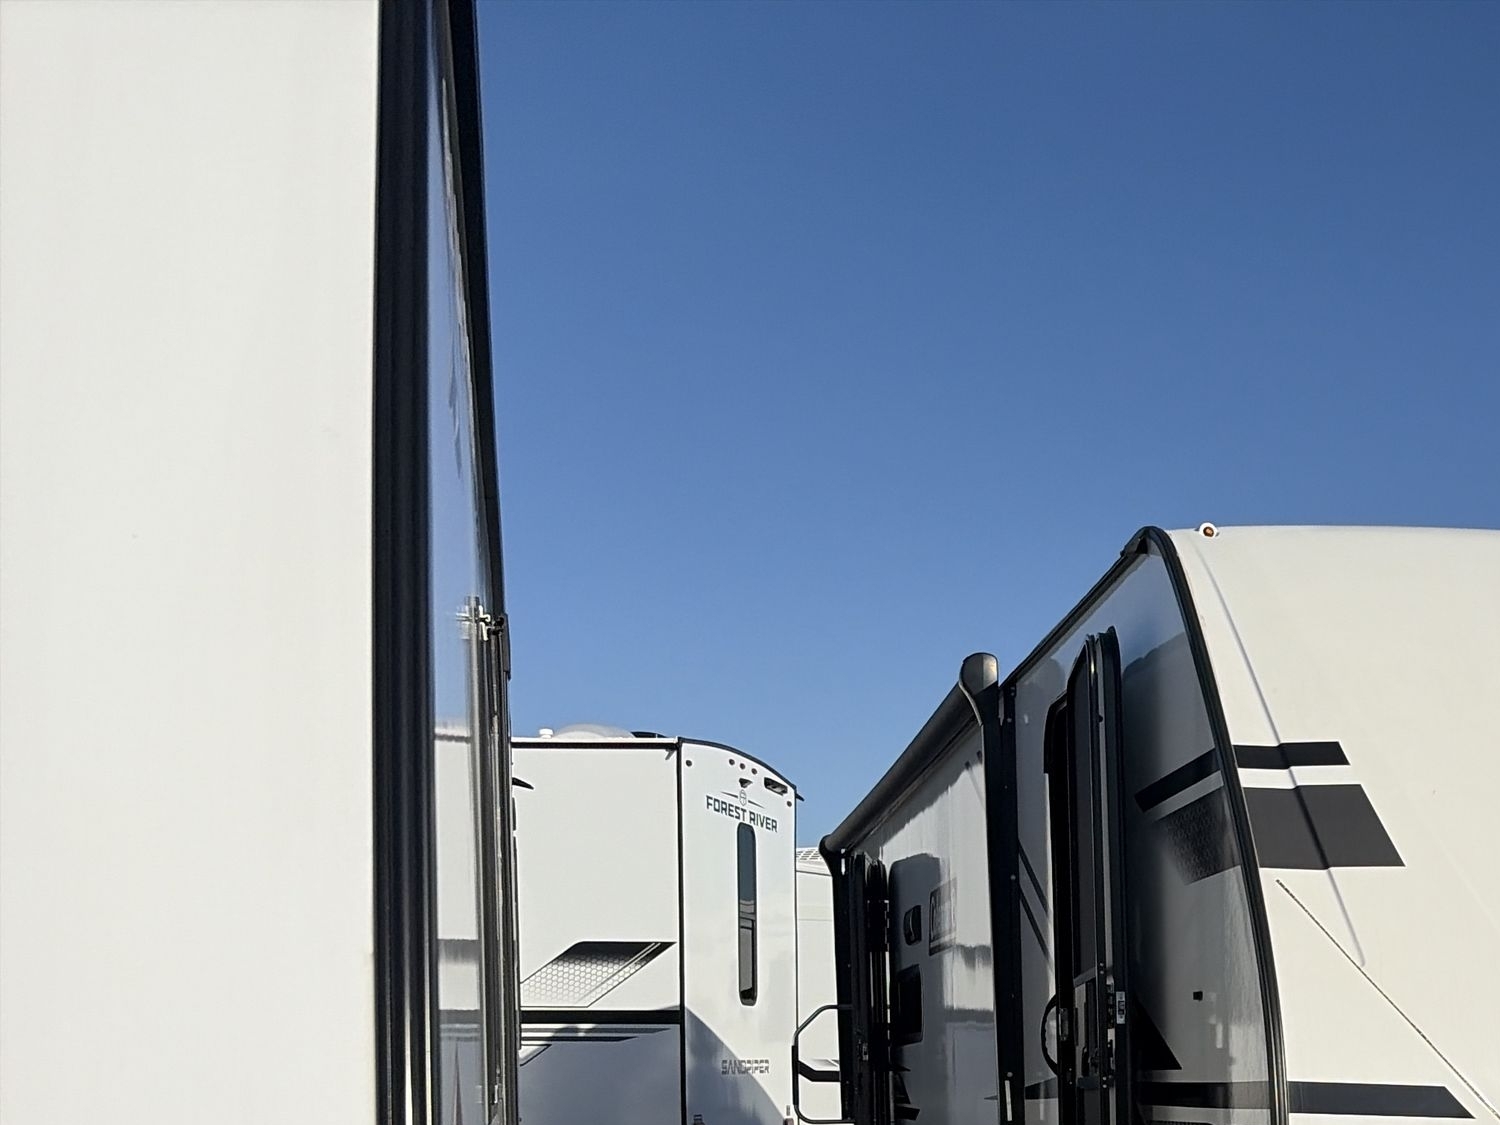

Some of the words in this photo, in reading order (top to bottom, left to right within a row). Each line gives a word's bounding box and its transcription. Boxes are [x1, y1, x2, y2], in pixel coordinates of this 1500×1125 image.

[706, 795, 747, 822] FOREST
[748, 810, 778, 832] RIVER
[721, 1059, 769, 1074] SANDPIPER
